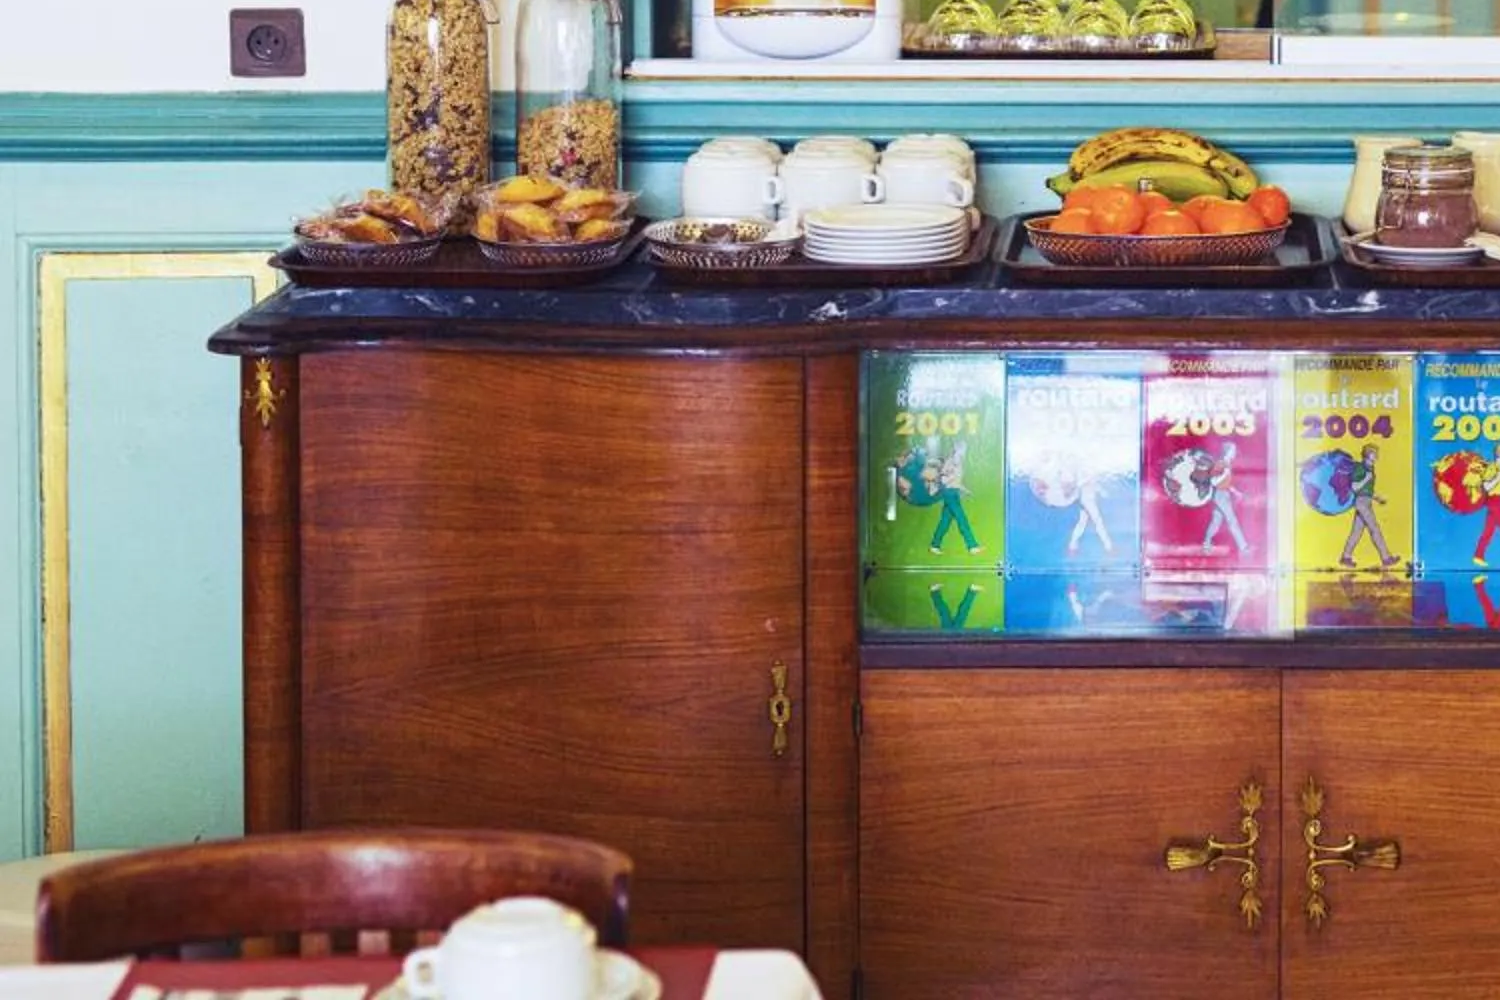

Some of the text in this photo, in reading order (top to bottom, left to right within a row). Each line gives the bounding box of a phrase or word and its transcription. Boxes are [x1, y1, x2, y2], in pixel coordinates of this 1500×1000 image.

[895, 411, 980, 436] 2001
[1165, 412, 1256, 437] 2003
[1301, 414, 1394, 439] 2004
